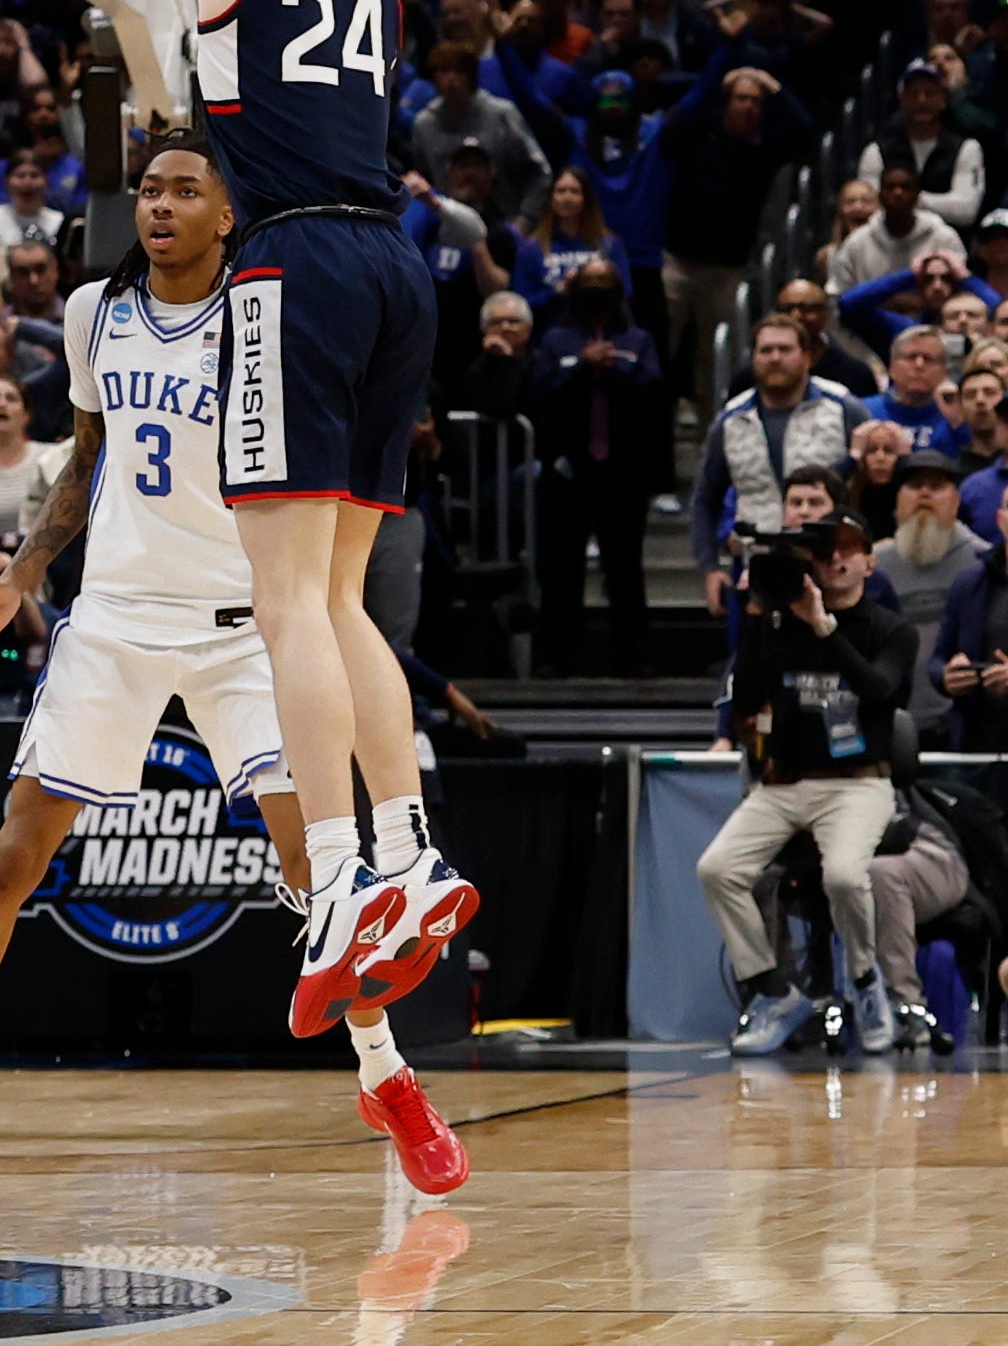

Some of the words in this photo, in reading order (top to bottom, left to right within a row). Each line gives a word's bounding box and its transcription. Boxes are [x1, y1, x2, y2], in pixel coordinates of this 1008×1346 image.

[102, 370, 221, 426] DUKE
[242, 296, 264, 473] HUSKIES
[135, 422, 172, 497] 3
[69, 788, 222, 836] MARCH
[79, 837, 281, 885] MADNESS
[112, 920, 162, 944] ELITE
